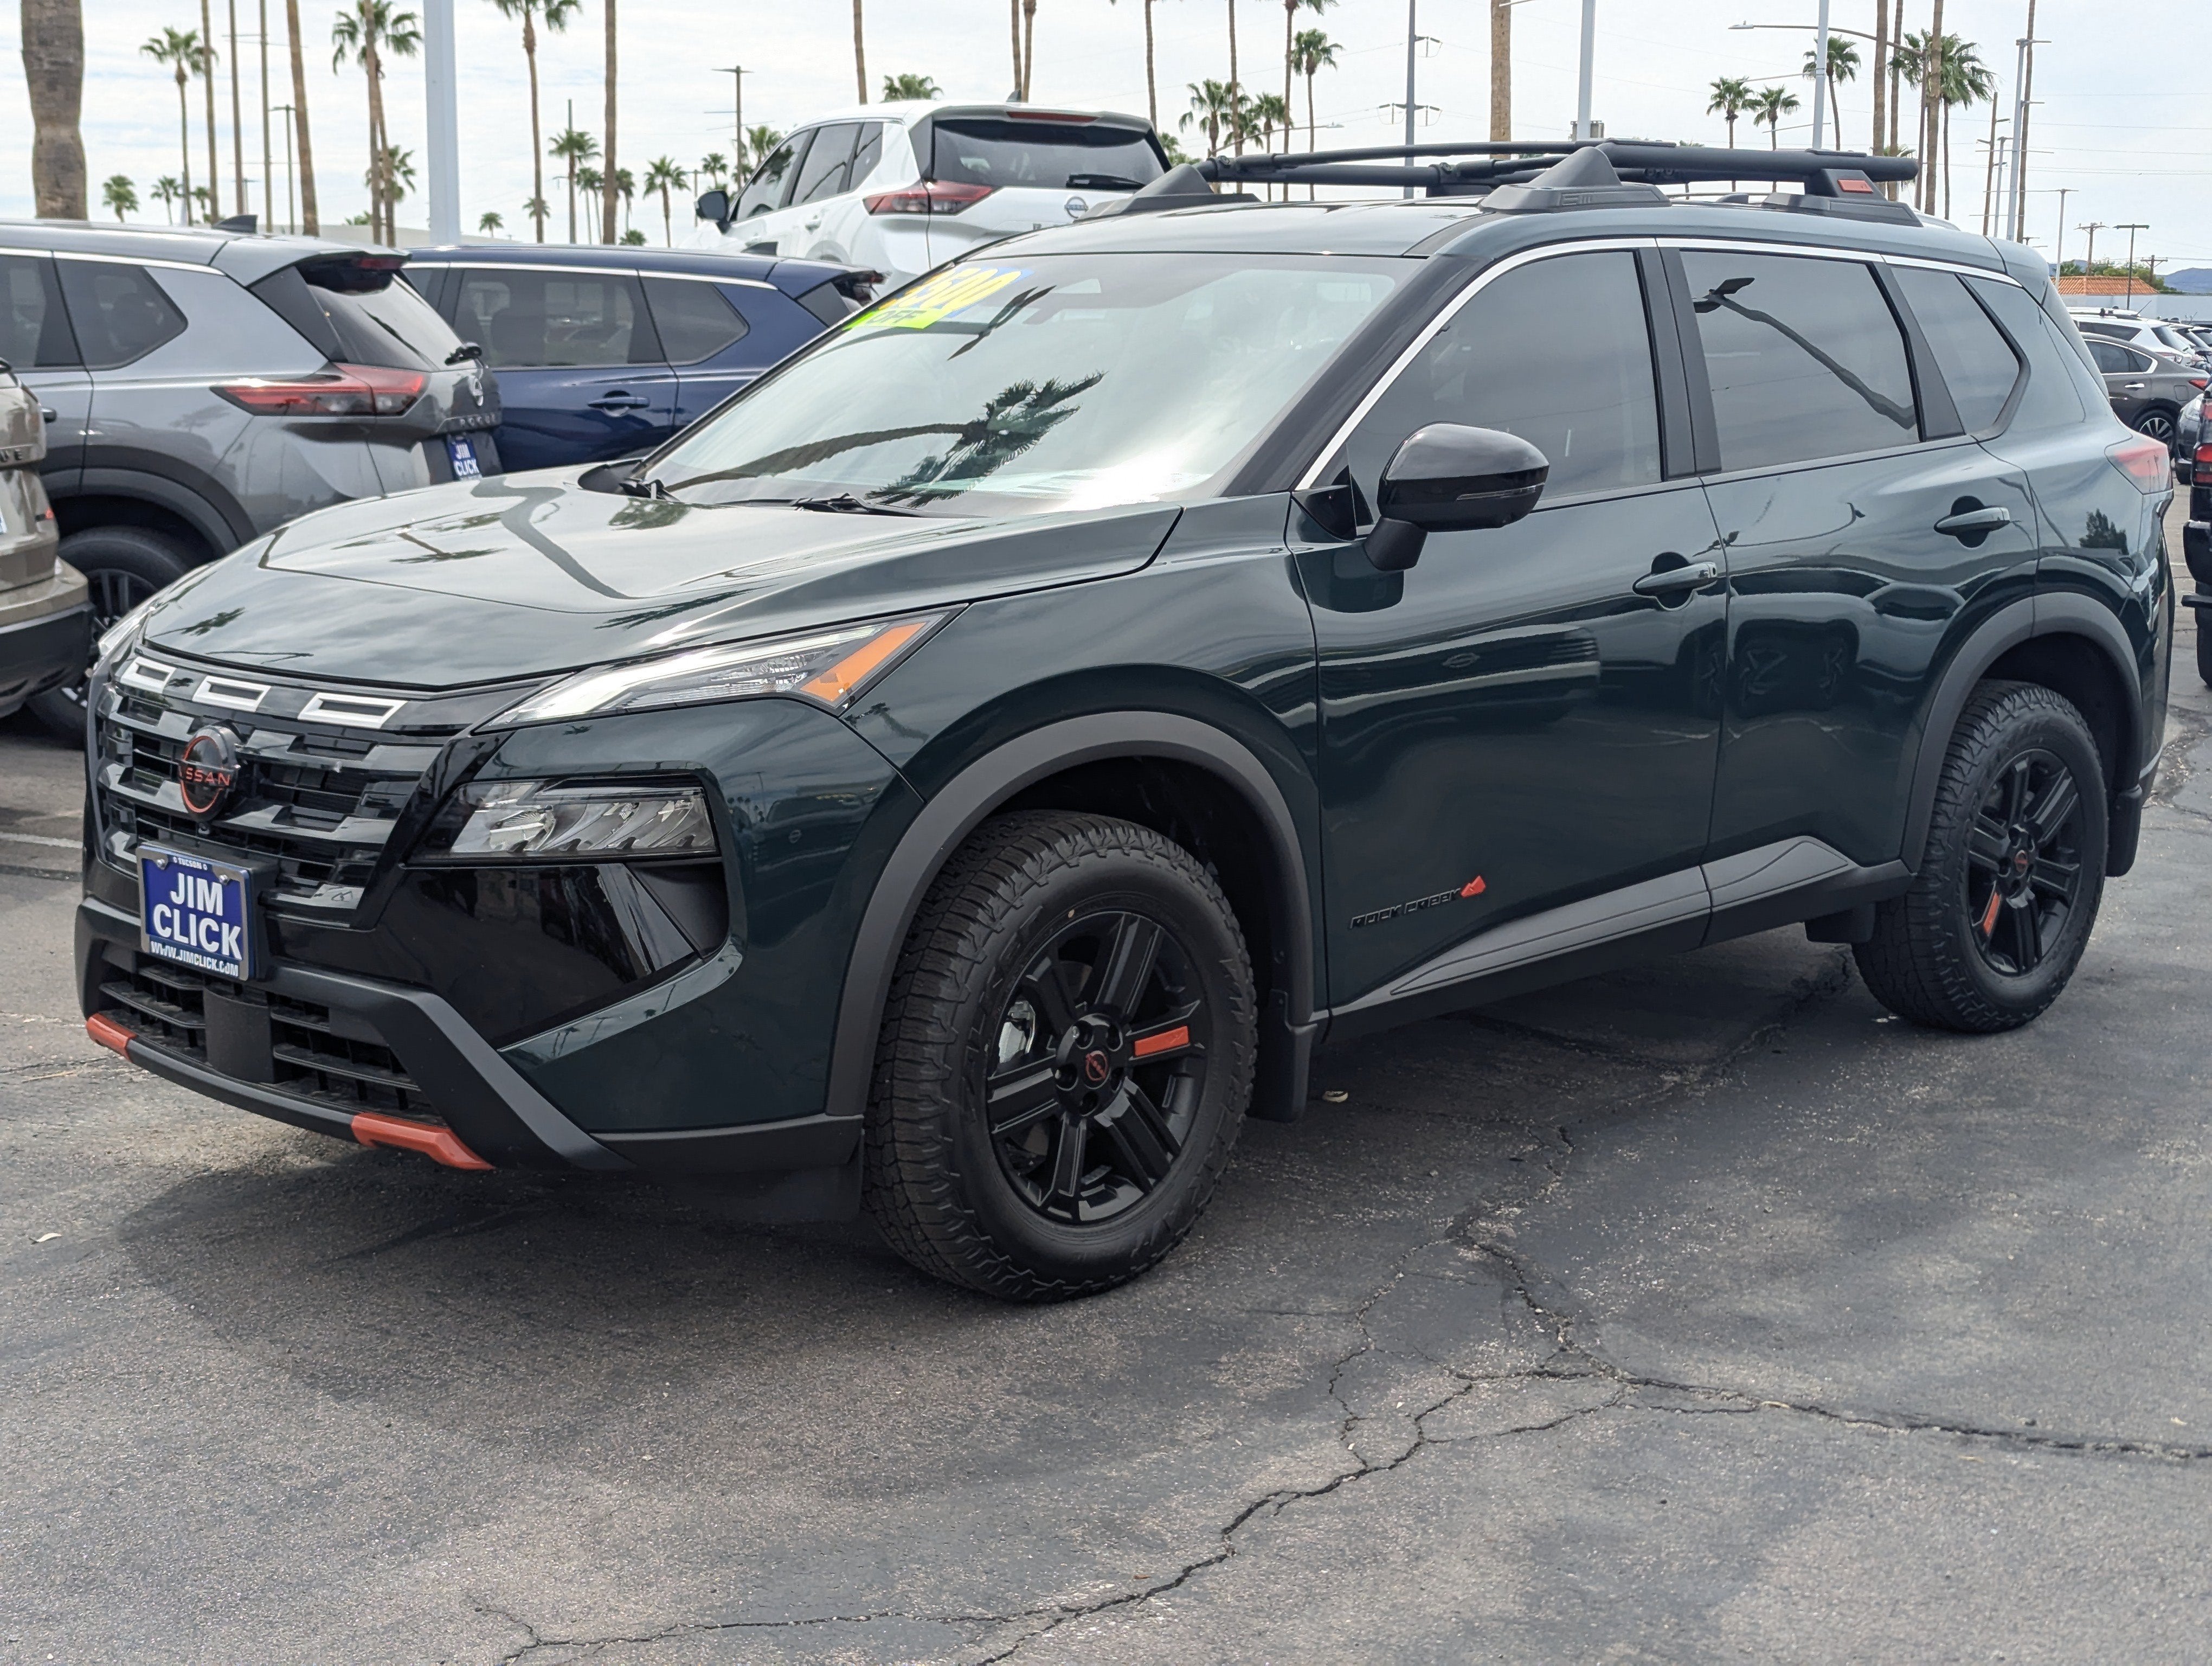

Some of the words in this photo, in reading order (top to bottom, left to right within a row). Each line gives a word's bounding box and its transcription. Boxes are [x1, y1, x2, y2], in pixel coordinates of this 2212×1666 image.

[867, 310, 927, 324] OFF
[177, 857, 202, 869] TUCSON
[170, 873, 223, 916] JIM
[153, 904, 242, 960] CLICK
